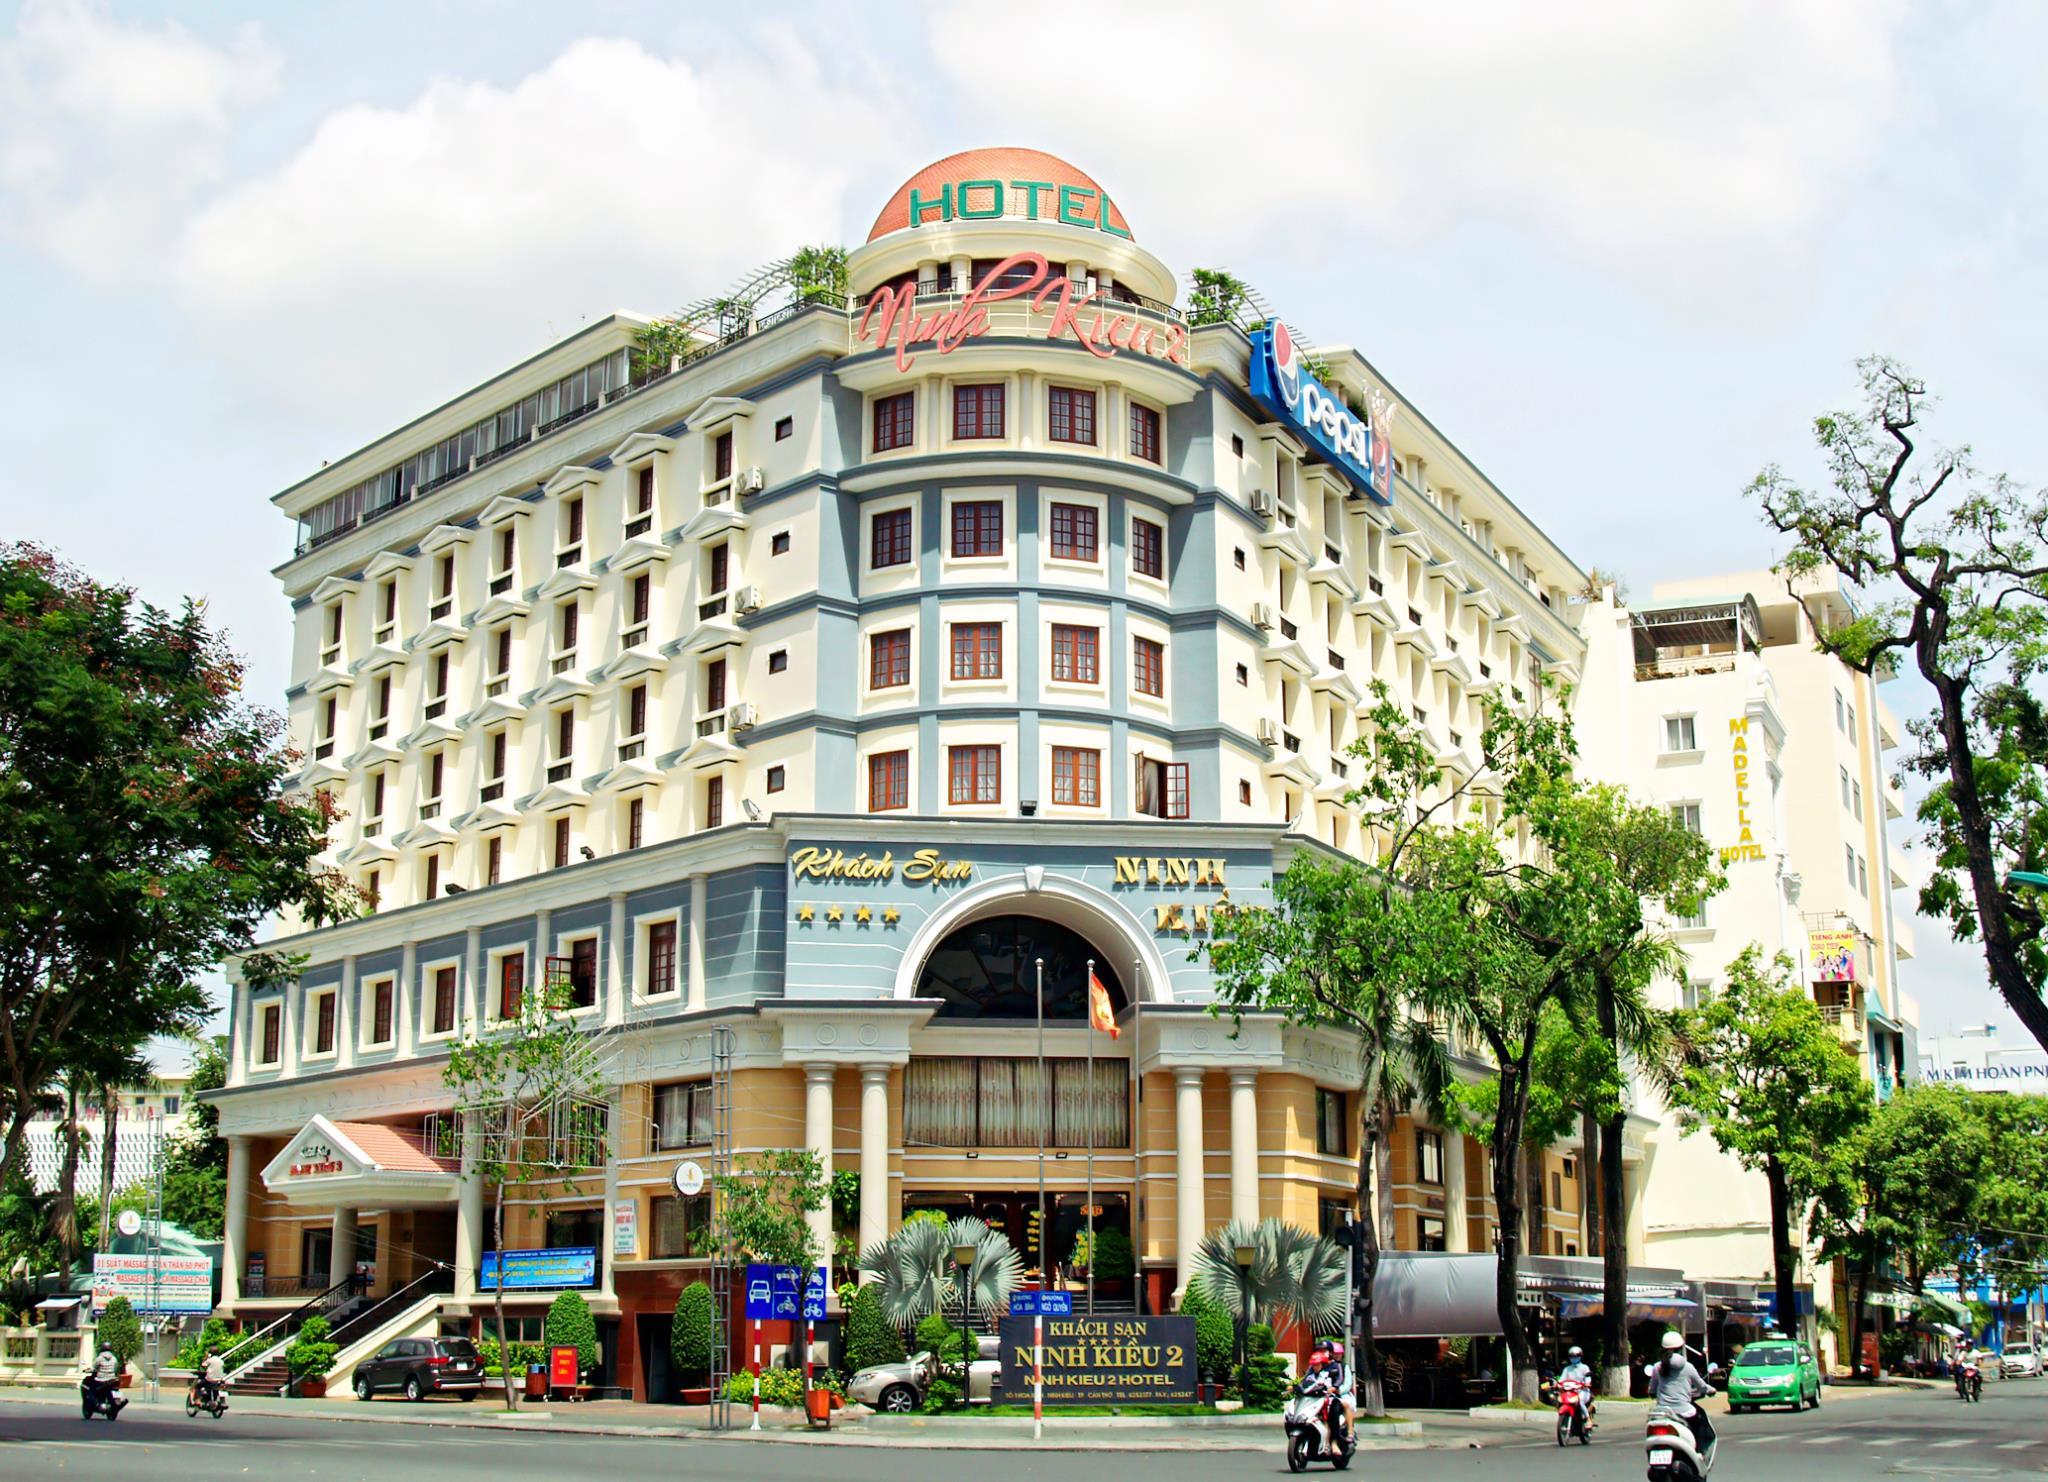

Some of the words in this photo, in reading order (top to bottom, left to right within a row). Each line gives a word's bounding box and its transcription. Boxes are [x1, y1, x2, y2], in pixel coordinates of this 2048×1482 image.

[909, 179, 1132, 238] HOTEL
[1161, 324, 1185, 364] 2
[1302, 383, 1373, 469] pepsi
[1729, 717, 1753, 842] MADELLA
[792, 846, 895, 880] Khách
[1719, 844, 1766, 862] HOTEL
[1113, 856, 1227, 885] NINH
[1944, 1067, 1973, 1081] KIM
[1049, 1318, 1108, 1336] KHÁCH
[1113, 1321, 1147, 1339] SẠN
[1093, 1337, 1160, 1368] KIỀU
[1166, 1345, 1184, 1367] 2
[1067, 1375, 1105, 1386] KIEU
[1107, 1375, 1117, 1386] 2
[1119, 1374, 1175, 1386] HOTEL
